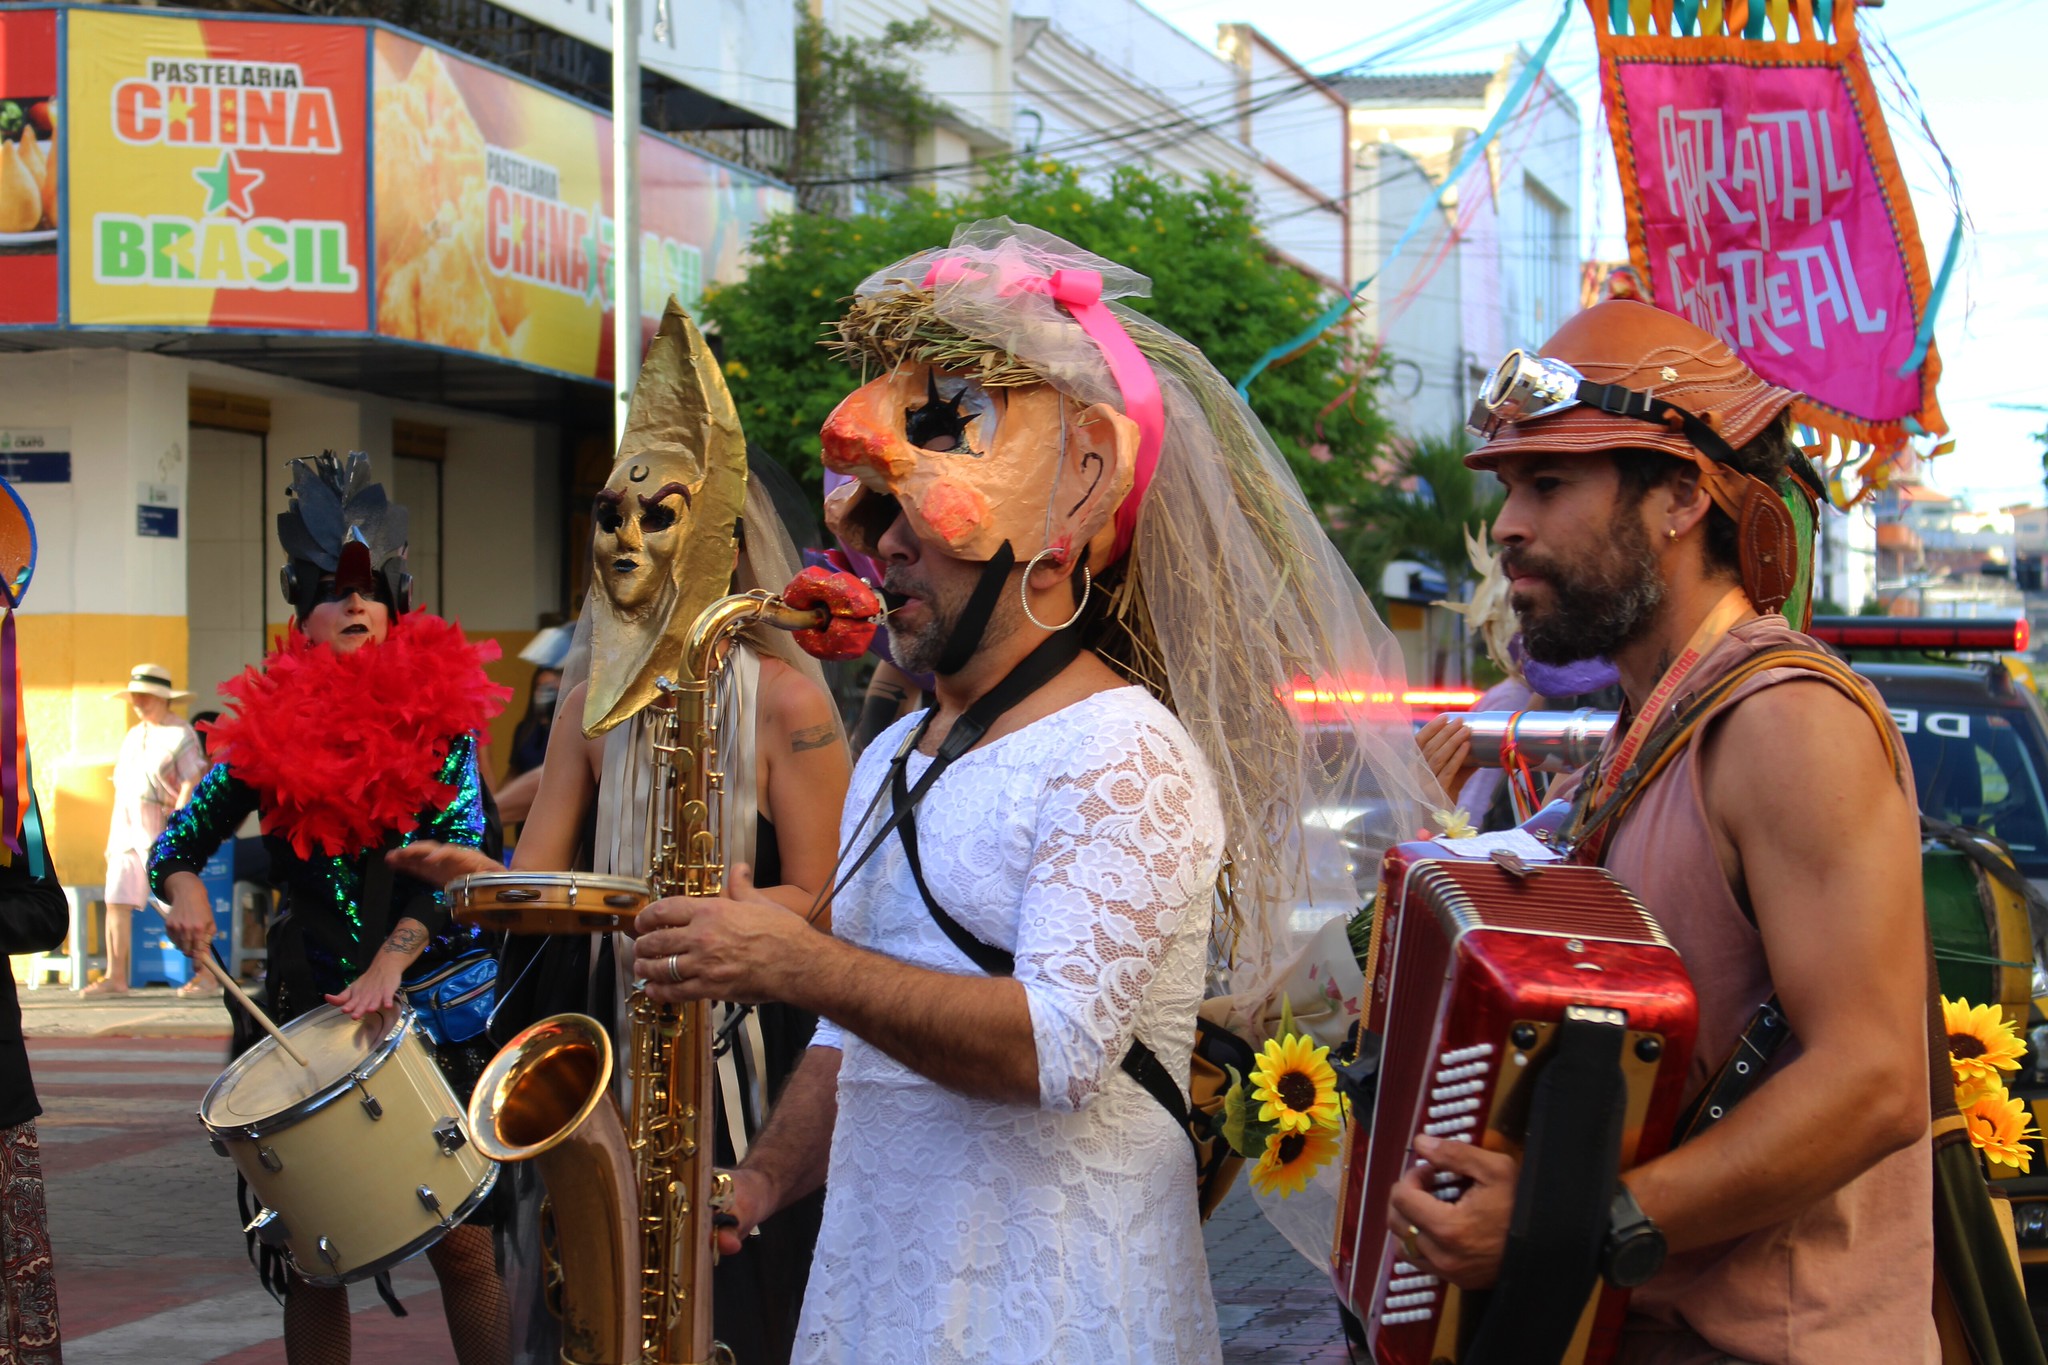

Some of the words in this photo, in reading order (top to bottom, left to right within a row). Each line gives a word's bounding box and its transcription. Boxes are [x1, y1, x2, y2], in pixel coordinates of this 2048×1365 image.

[151, 62, 298, 88] PASTELARIA
[116, 83, 337, 149] CHINA
[486, 150, 558, 201] PASTELARIA
[100, 220, 352, 285] BRASIL
[487, 184, 588, 292] CHINA
